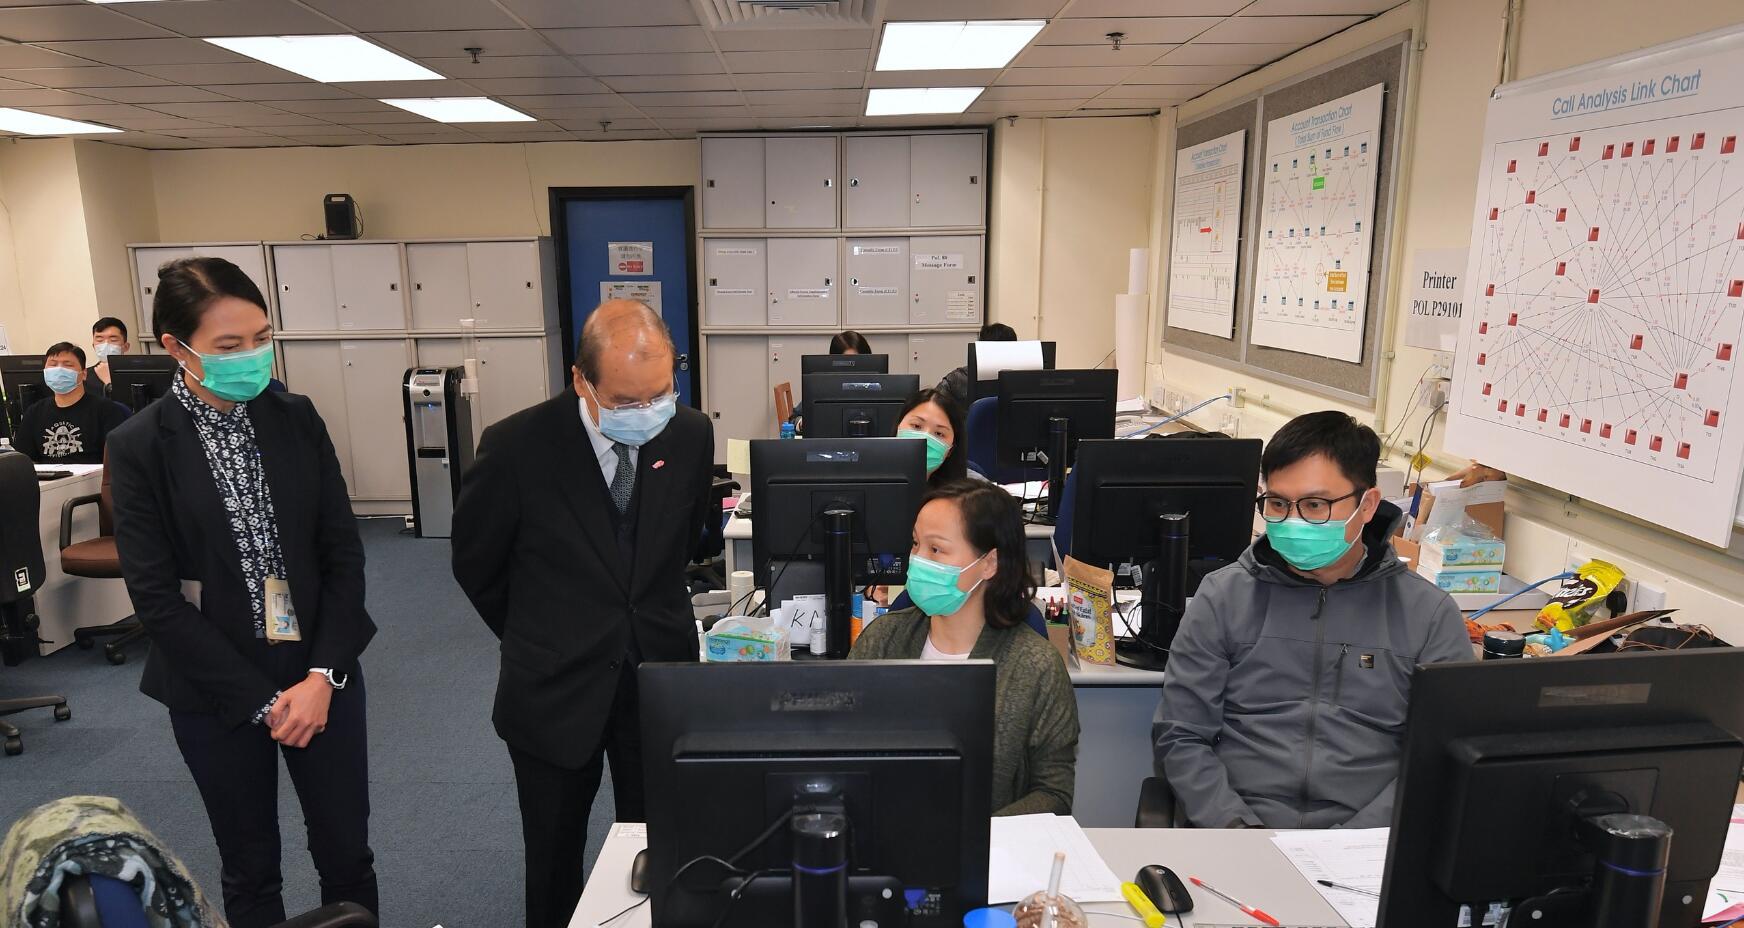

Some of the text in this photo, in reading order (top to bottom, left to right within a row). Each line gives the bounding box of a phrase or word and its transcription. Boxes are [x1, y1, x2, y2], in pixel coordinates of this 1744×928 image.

[1552, 69, 1702, 116] Call Analysis Link Chart
[1291, 104, 1353, 131] Account Transaction Chart
[1422, 271, 1457, 290] Printer
[1412, 299, 1463, 319] POL P29101
